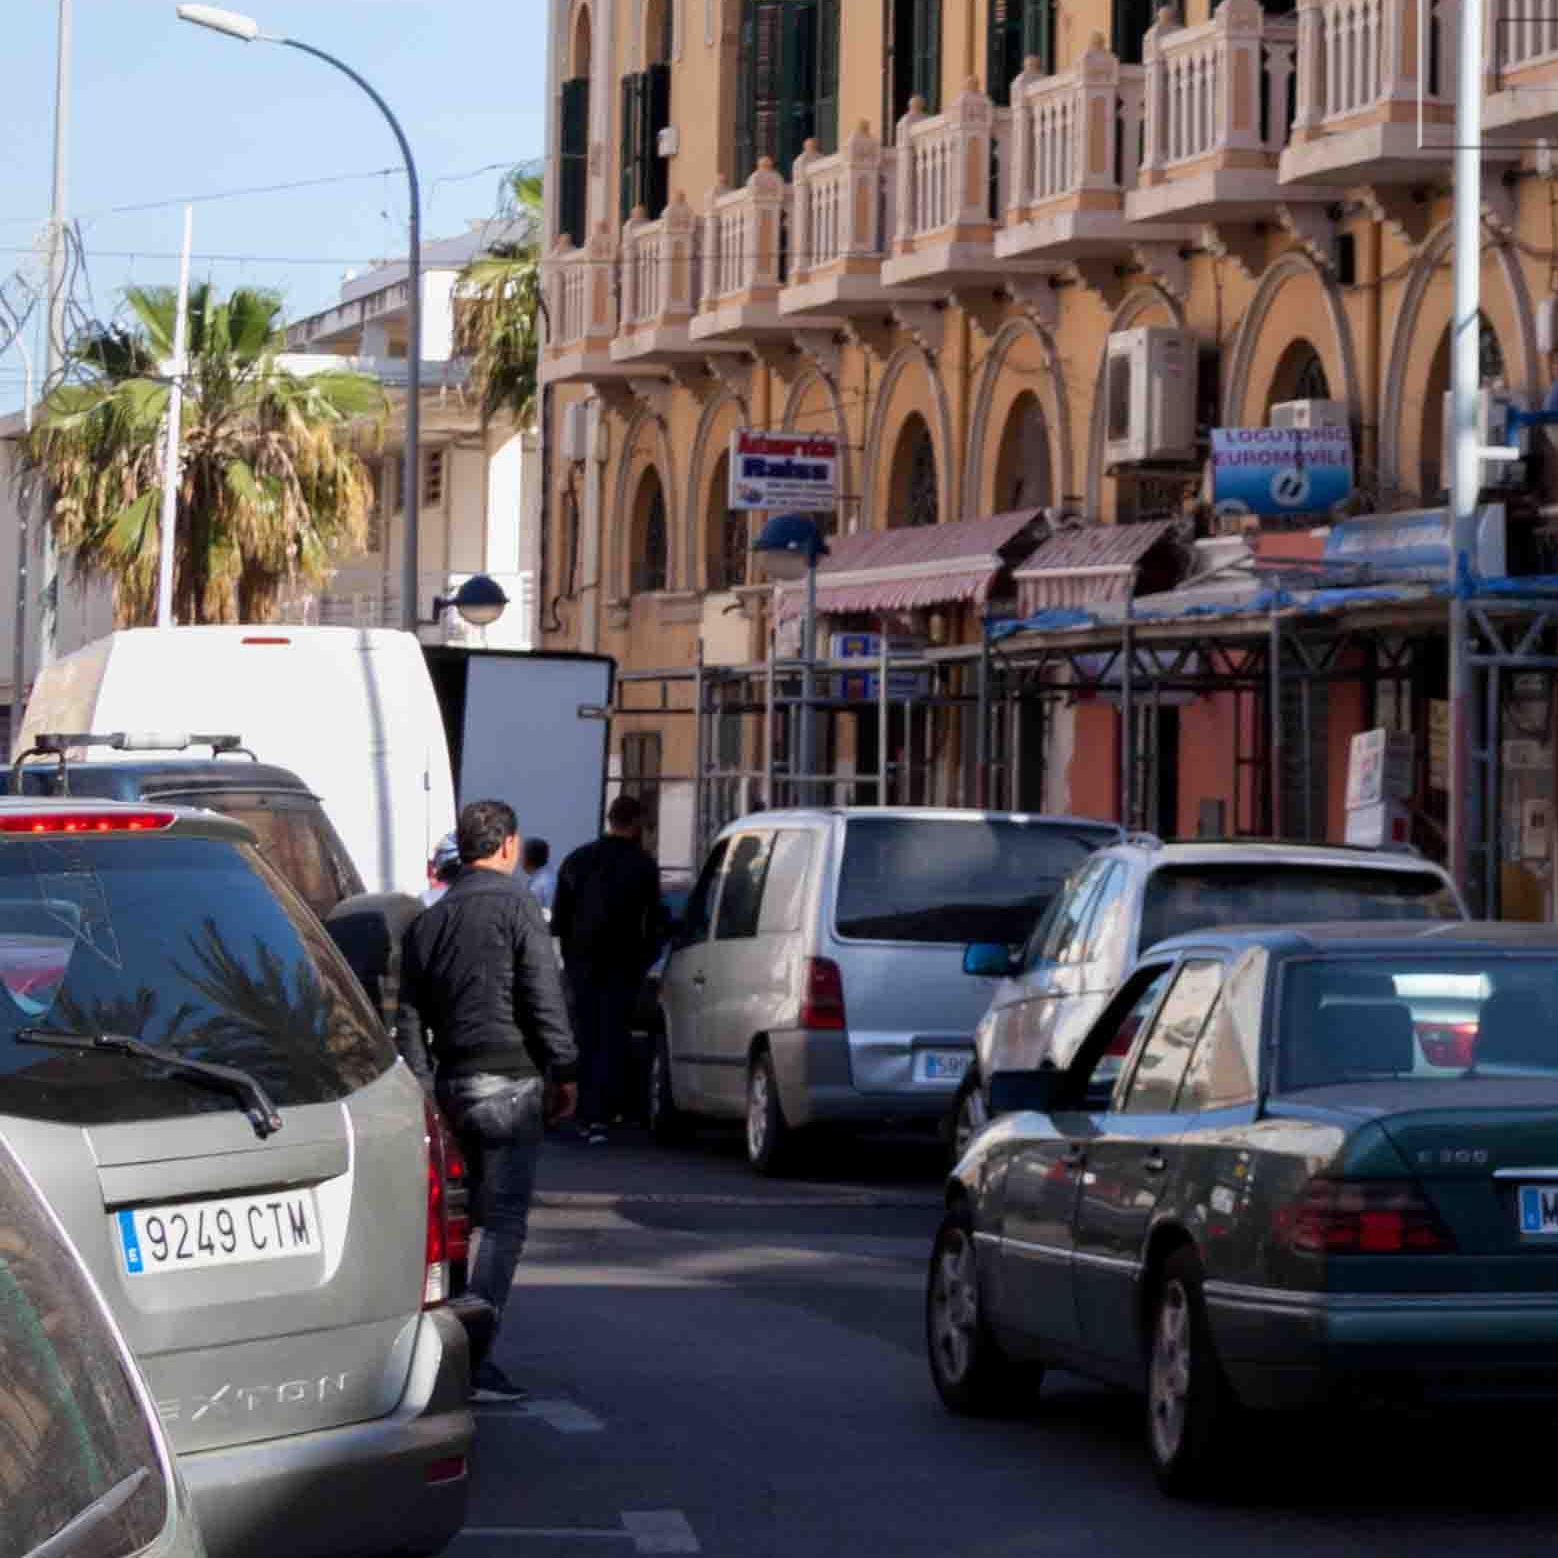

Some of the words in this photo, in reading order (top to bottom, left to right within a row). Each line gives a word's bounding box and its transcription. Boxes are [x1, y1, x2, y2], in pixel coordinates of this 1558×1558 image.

[145, 1208, 237, 1262] 9249
[246, 1199, 311, 1250] CTM
[157, 1371, 349, 1421] EXTON
